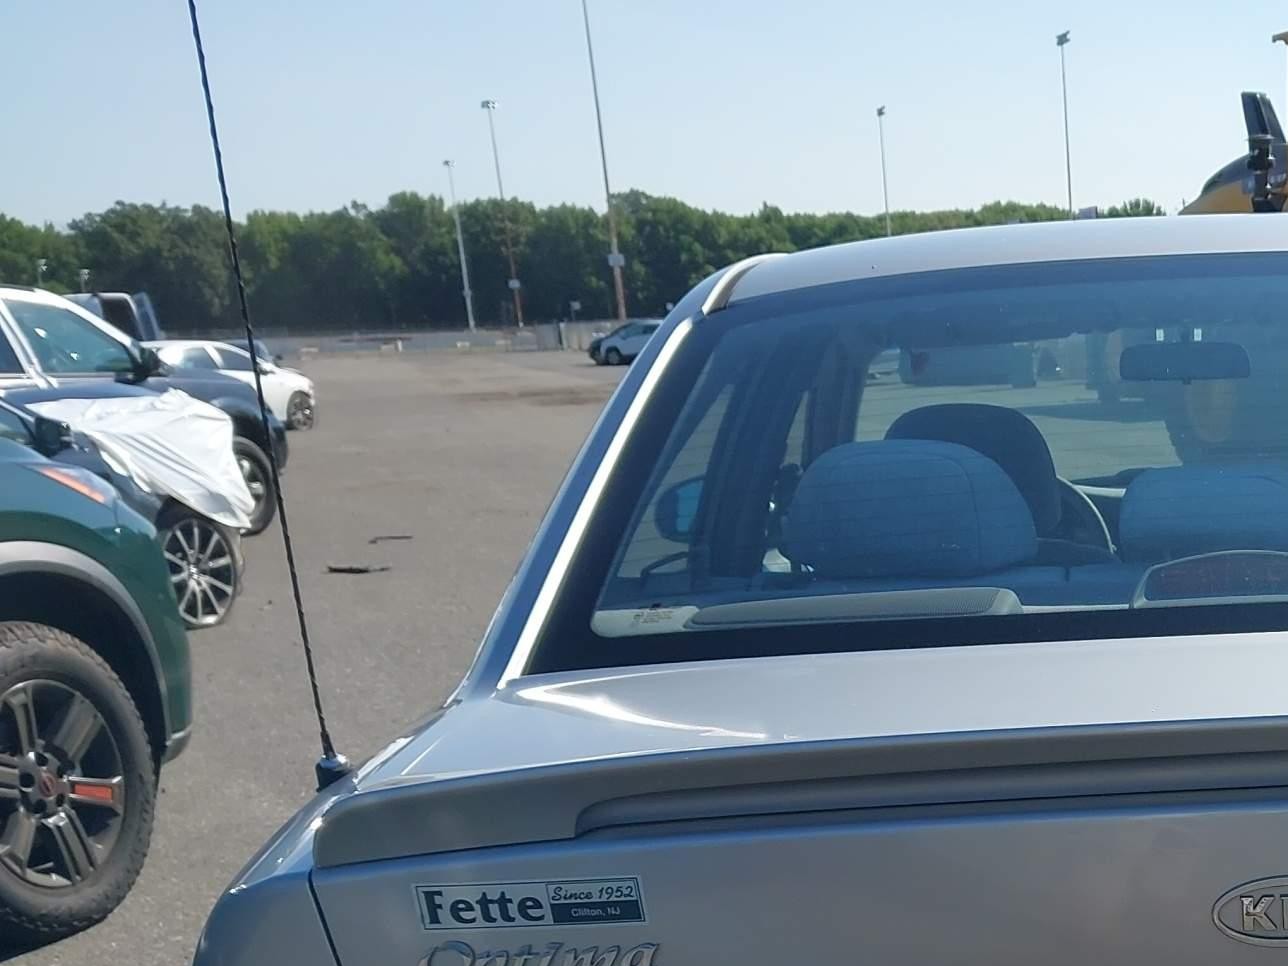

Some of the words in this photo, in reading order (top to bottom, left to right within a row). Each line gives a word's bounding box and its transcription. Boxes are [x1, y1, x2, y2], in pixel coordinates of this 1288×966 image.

[551, 886, 594, 901] Since
[598, 885, 635, 900] 1952
[422, 889, 546, 925] Fette
